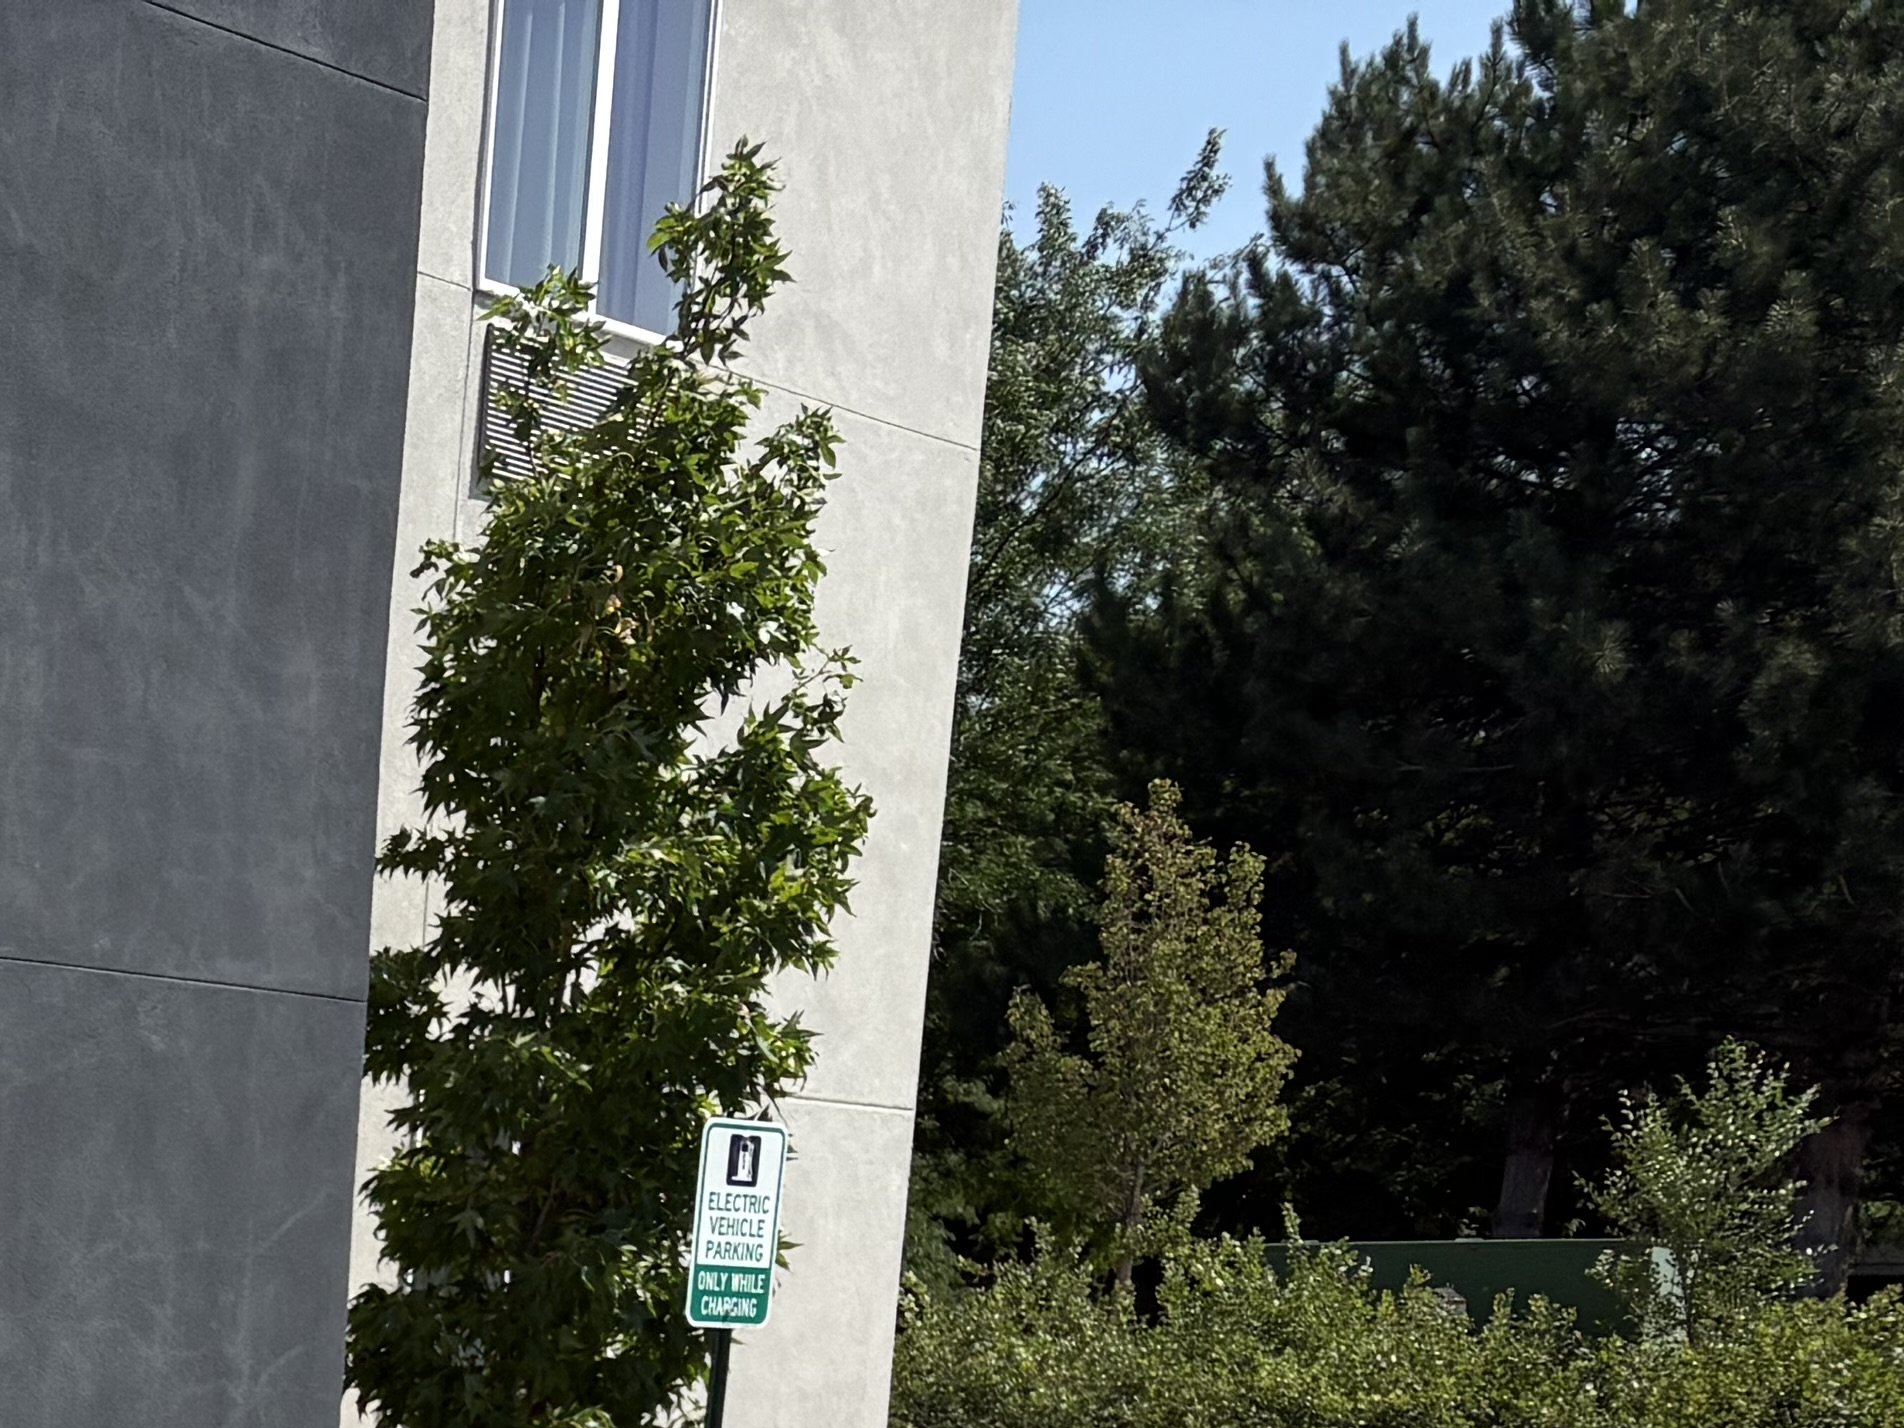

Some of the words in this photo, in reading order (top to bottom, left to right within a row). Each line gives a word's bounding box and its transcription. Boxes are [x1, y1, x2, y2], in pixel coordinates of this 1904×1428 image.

[708, 1191, 771, 1215] ELECTRIC
[709, 1215, 766, 1239] VEHICLE
[705, 1239, 764, 1263] PARKING
[697, 1270, 729, 1291] ONLY
[731, 1272, 766, 1294] WHILE
[700, 1295, 758, 1318] CHARGING
